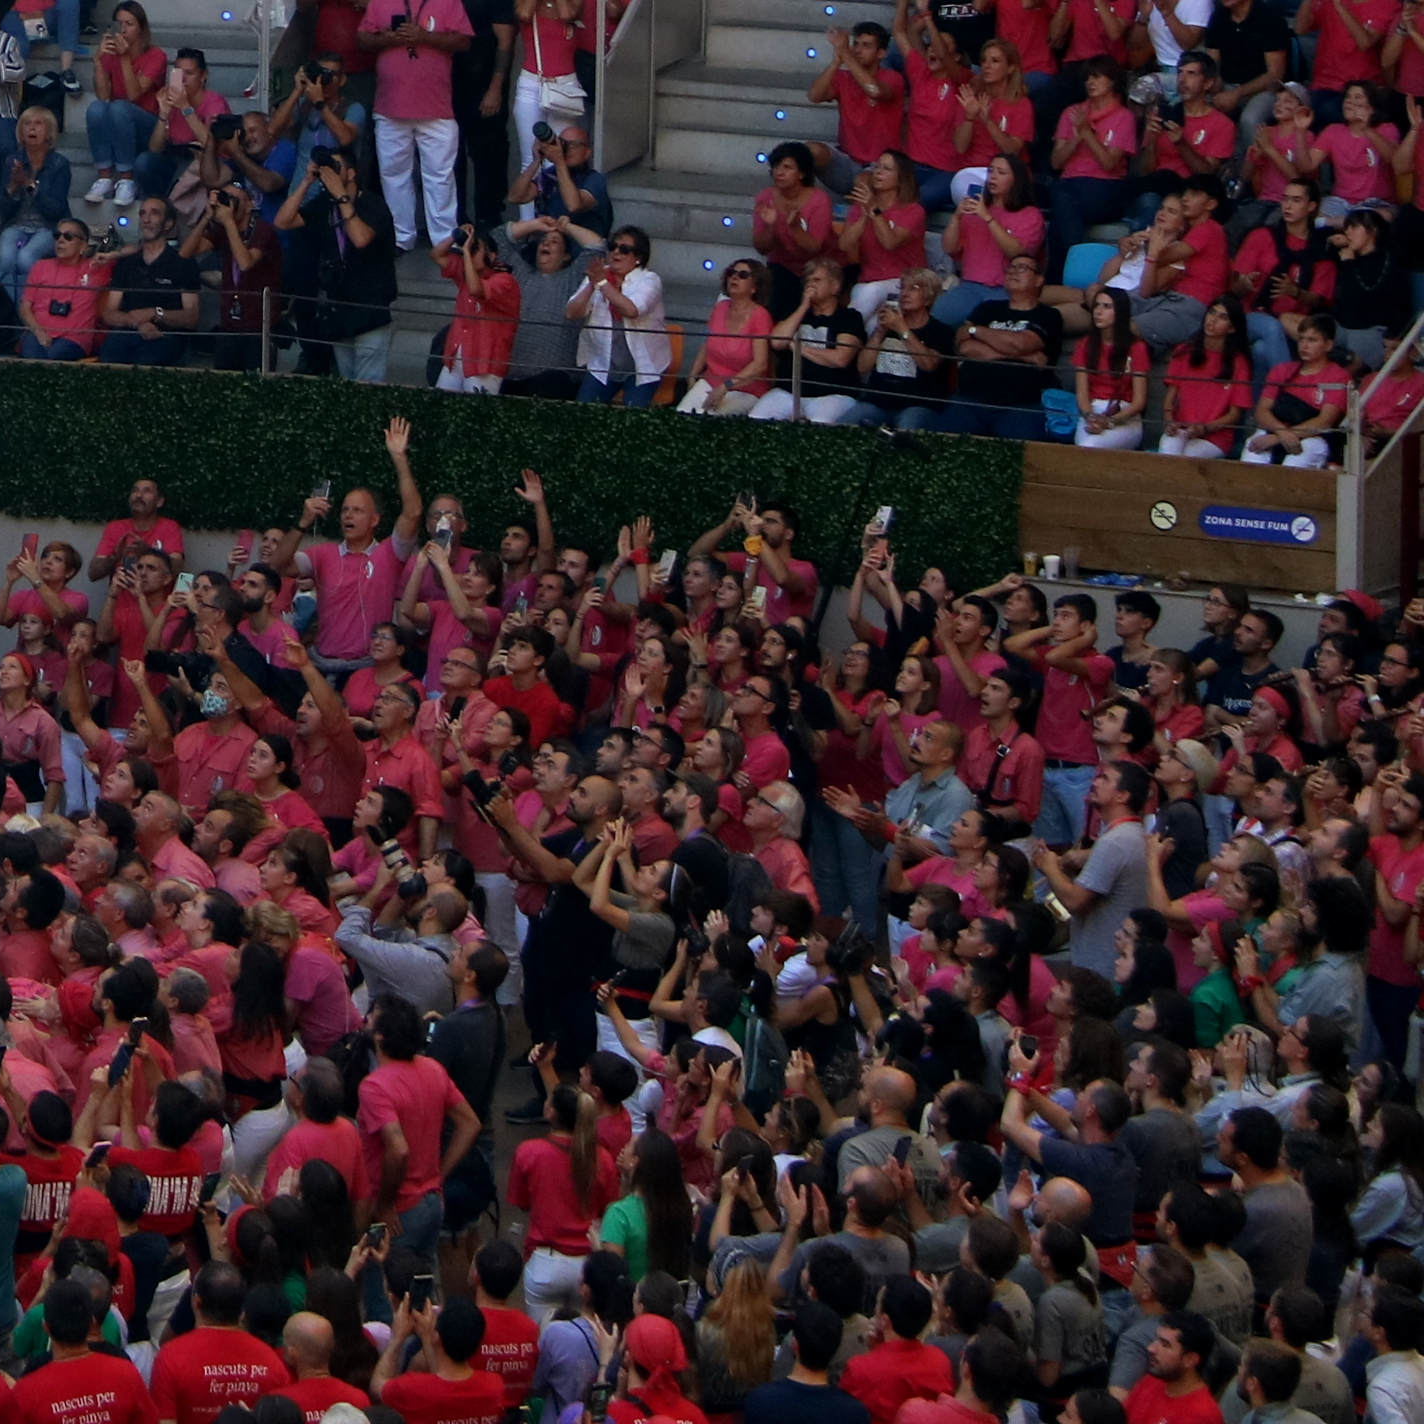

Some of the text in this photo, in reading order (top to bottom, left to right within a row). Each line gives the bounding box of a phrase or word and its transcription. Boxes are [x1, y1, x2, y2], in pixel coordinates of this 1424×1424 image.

[1204, 514, 1290, 532] ZONA SENSE FUM
[481, 1341, 520, 1356] nascuts
[202, 1363, 269, 1379] nascuts per
[208, 1378, 260, 1396] fer pinya
[50, 1391, 116, 1414] nascuts per
